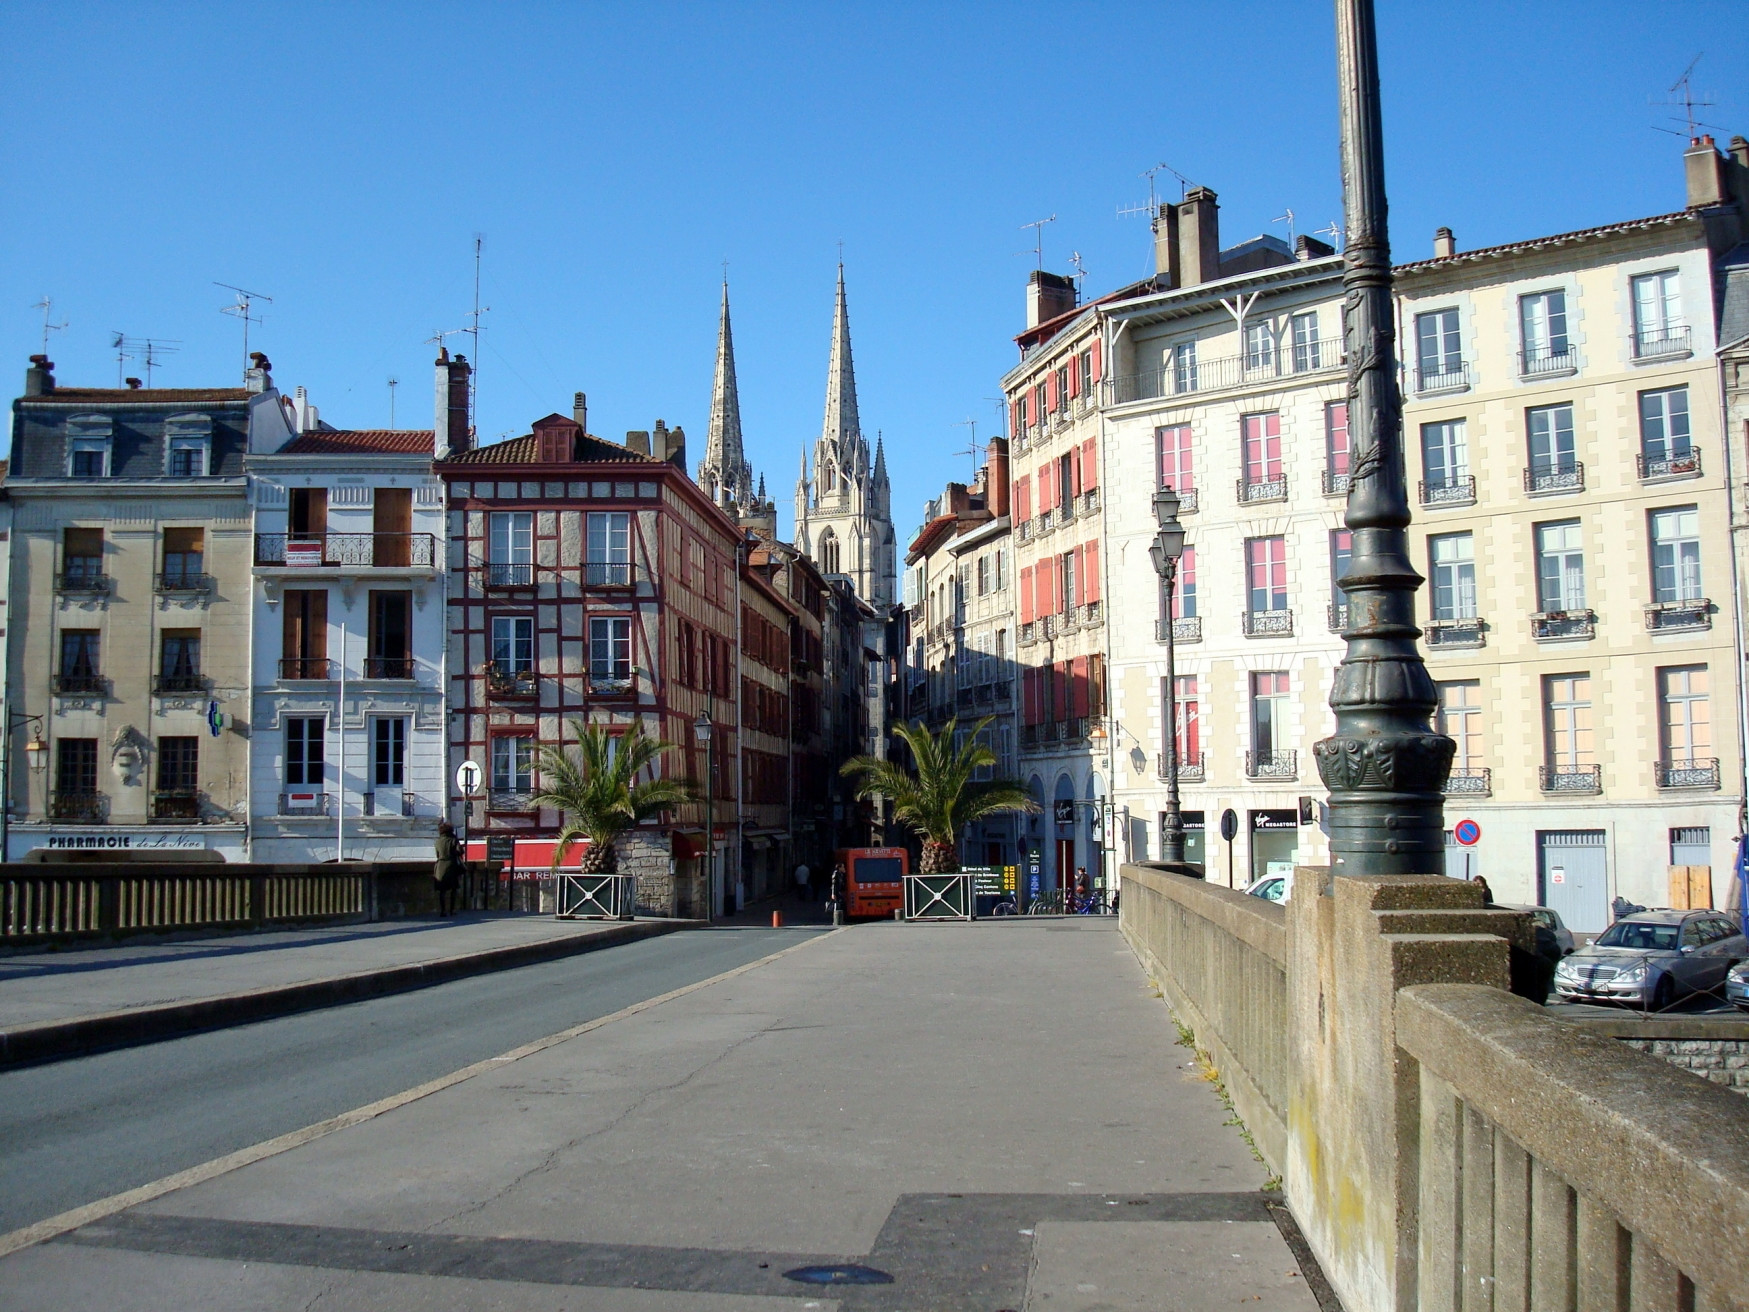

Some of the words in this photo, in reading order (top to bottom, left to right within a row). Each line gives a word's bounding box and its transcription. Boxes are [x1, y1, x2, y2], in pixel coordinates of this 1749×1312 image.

[49, 836, 130, 848] PHARMACIE
[136, 837, 149, 848] de
[149, 835, 169, 848] La
[169, 835, 201, 848] Nive
[536, 871, 558, 880] REM
